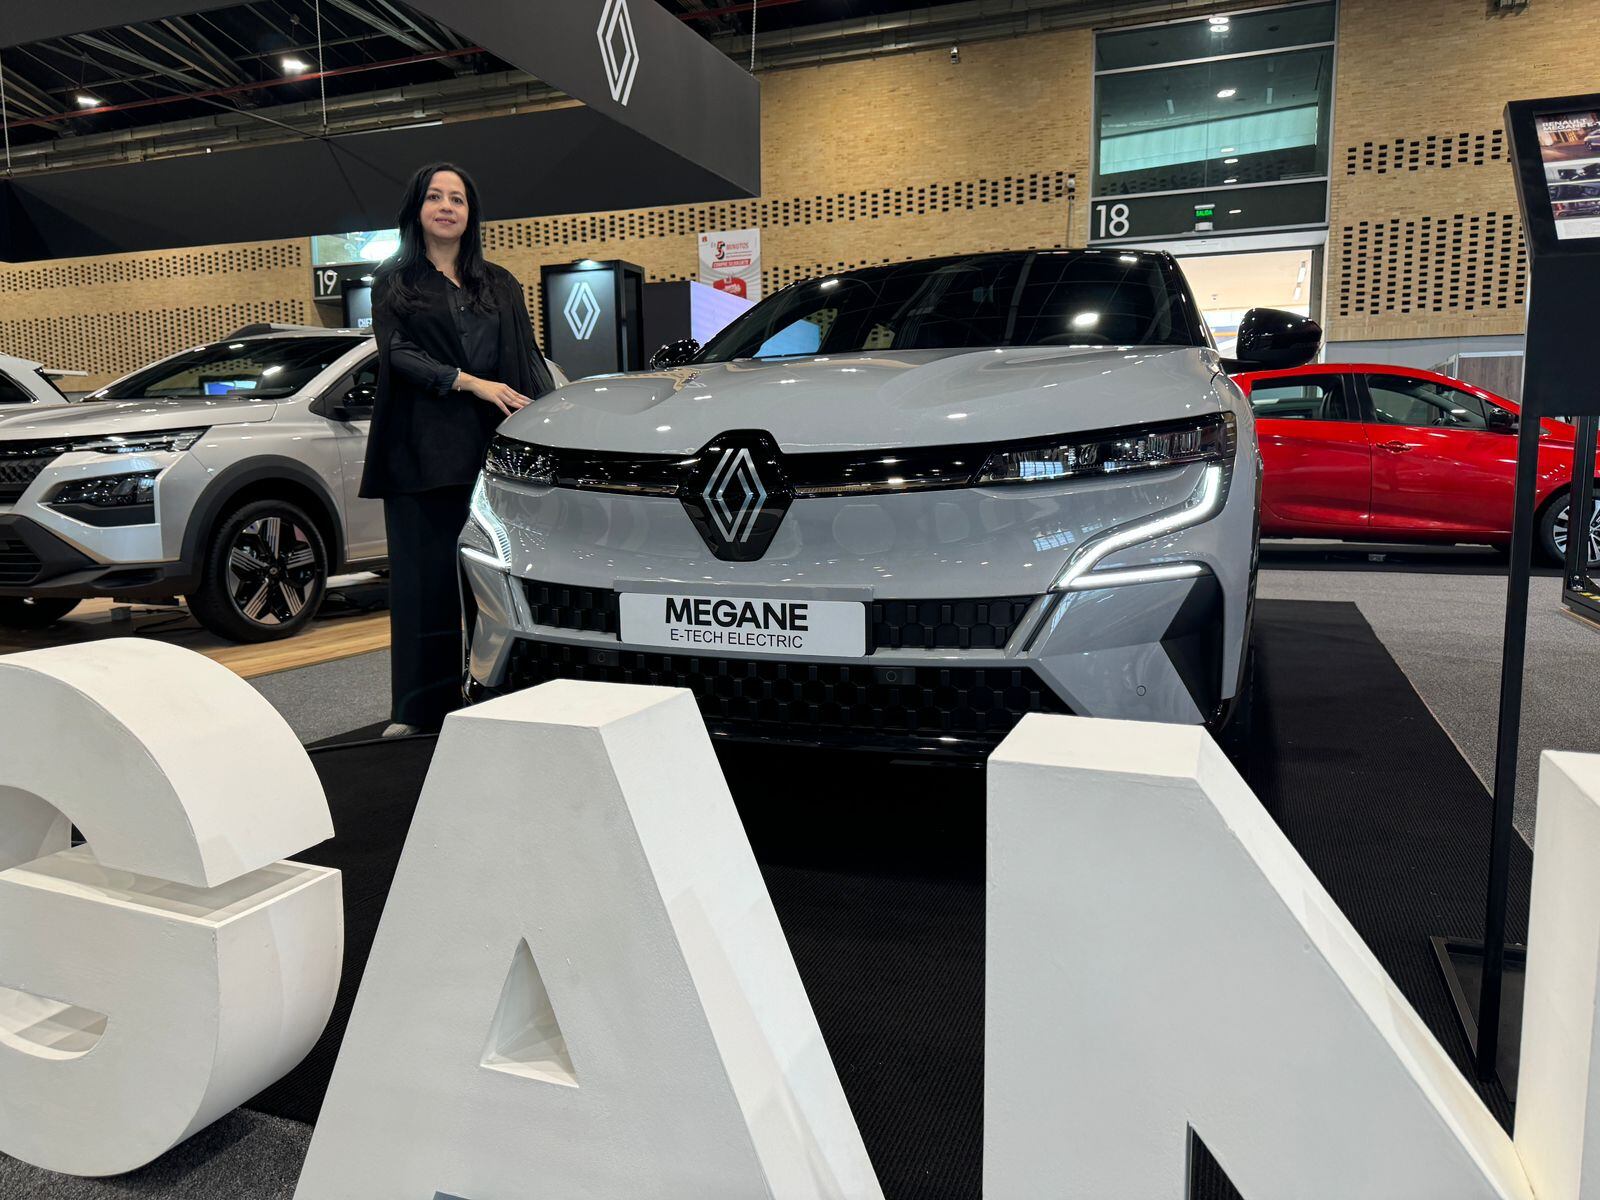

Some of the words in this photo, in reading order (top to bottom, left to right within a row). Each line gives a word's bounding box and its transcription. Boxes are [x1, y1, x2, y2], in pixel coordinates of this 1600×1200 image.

[1096, 203, 1130, 238] 18
[316, 269, 338, 295] 19
[665, 597, 808, 632] MEGANE
[670, 628, 723, 644] E-TECH
[728, 631, 803, 649] ELECTRIC
